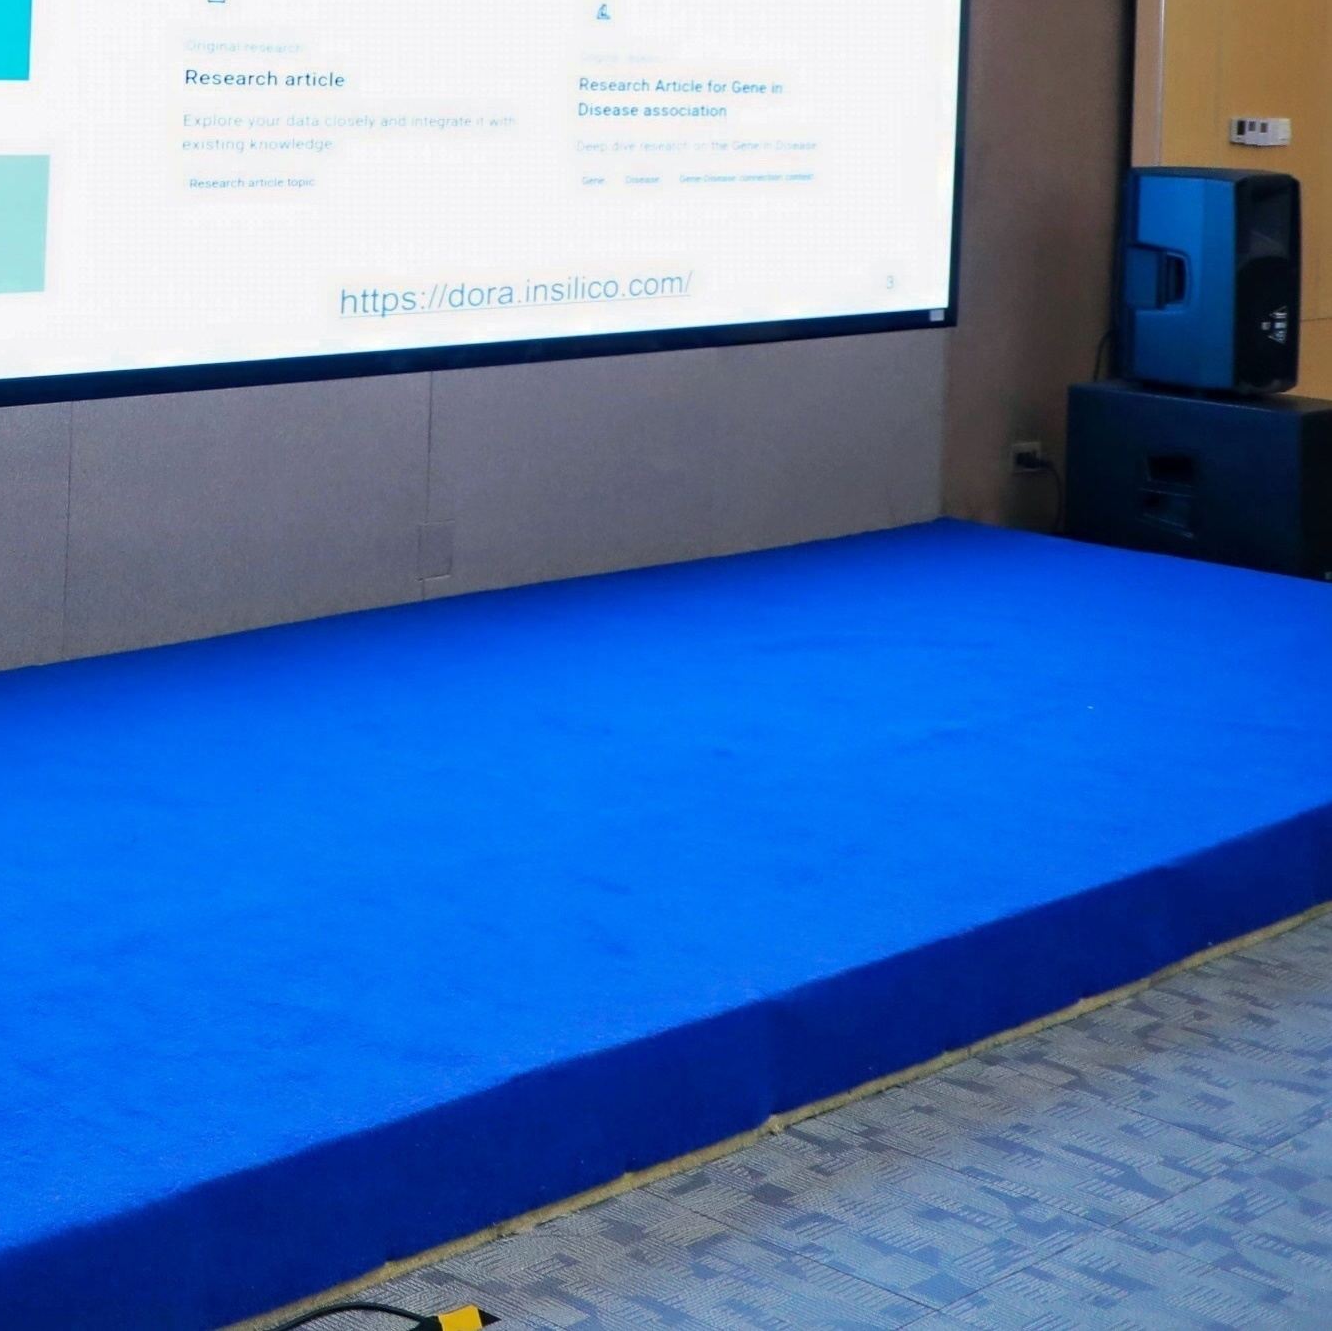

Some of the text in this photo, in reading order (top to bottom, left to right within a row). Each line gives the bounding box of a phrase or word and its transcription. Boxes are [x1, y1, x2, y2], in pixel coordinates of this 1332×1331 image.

[184, 69, 346, 87] Research article
[578, 76, 650, 92] Research
[654, 79, 703, 93] Article
[706, 79, 727, 94] for
[731, 80, 767, 94] Gene
[577, 101, 727, 118] Disease association
[182, 113, 244, 128] Explore
[286, 114, 320, 127] data
[324, 114, 376, 129] closely
[379, 115, 407, 128] and
[410, 116, 472, 131] integrate
[181, 138, 333, 154] existing knowledge
[188, 177, 314, 189] Research article topic
[339, 270, 693, 320] https://dora.insilico.com/
